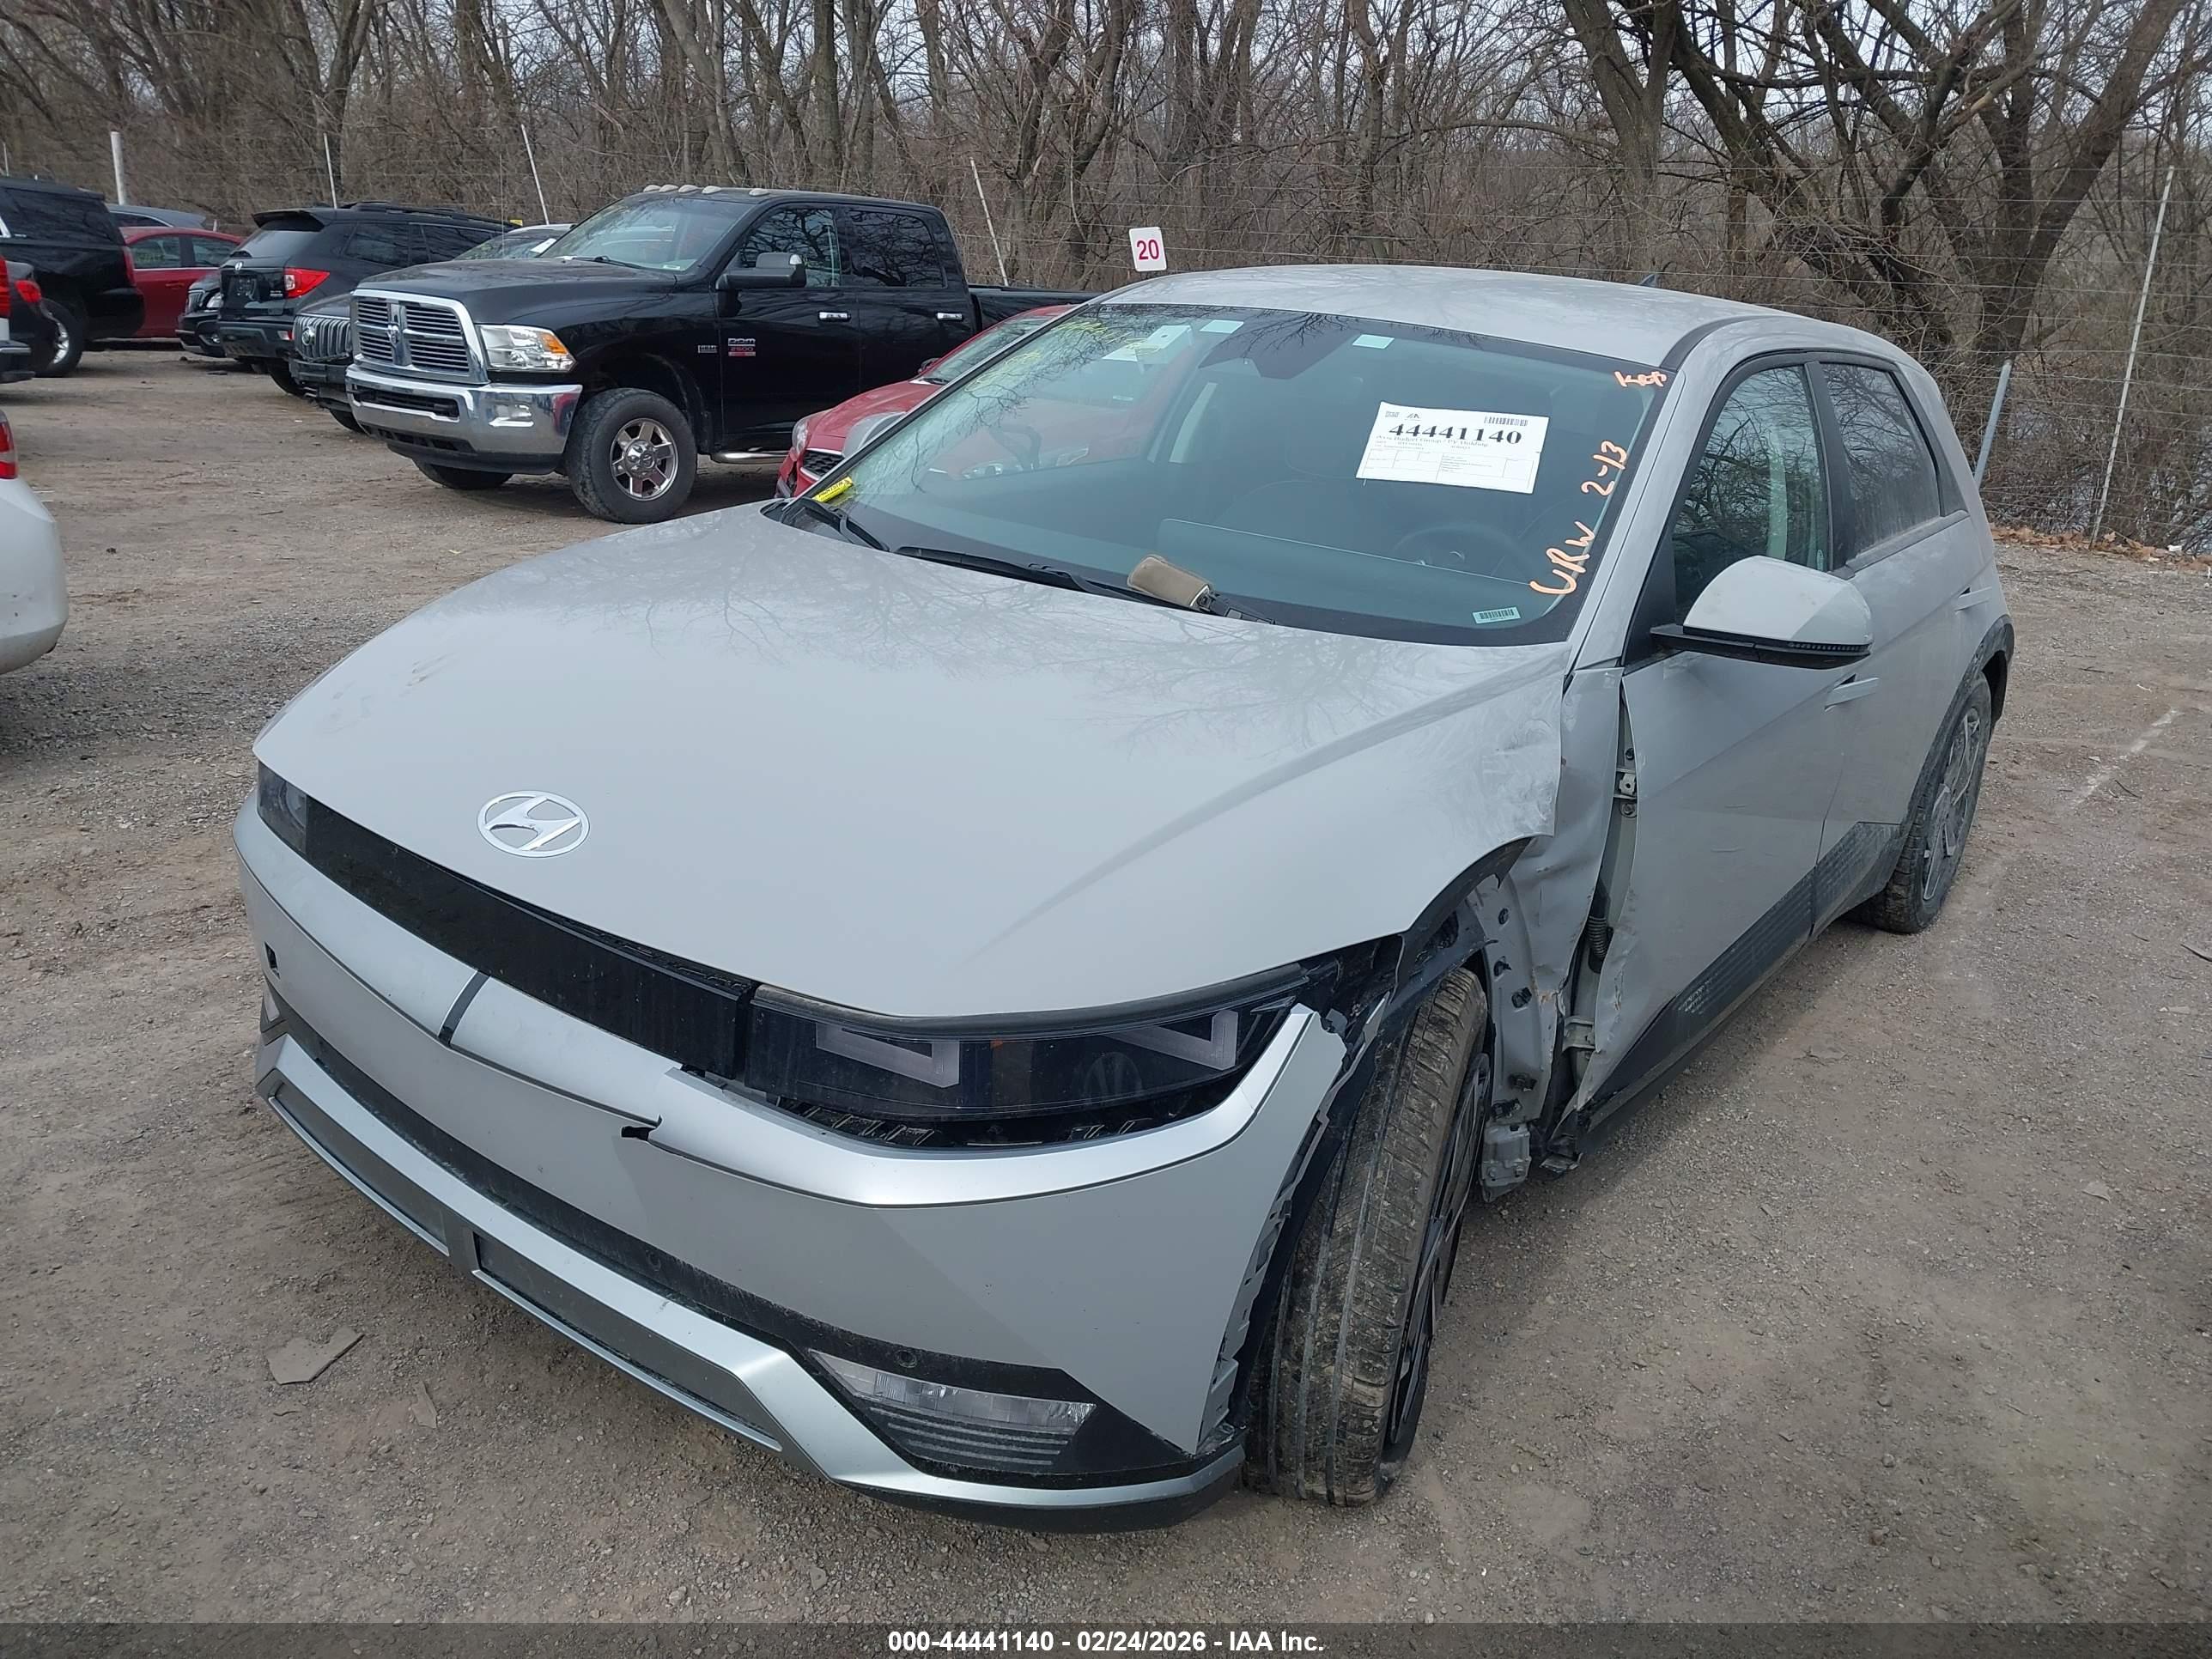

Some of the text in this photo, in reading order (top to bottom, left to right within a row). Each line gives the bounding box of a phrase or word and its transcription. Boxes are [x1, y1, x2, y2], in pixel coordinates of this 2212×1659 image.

[1137, 239, 1159, 260] 20
[1389, 423, 1522, 445] 44441140
[1580, 440, 1628, 496] 2-13
